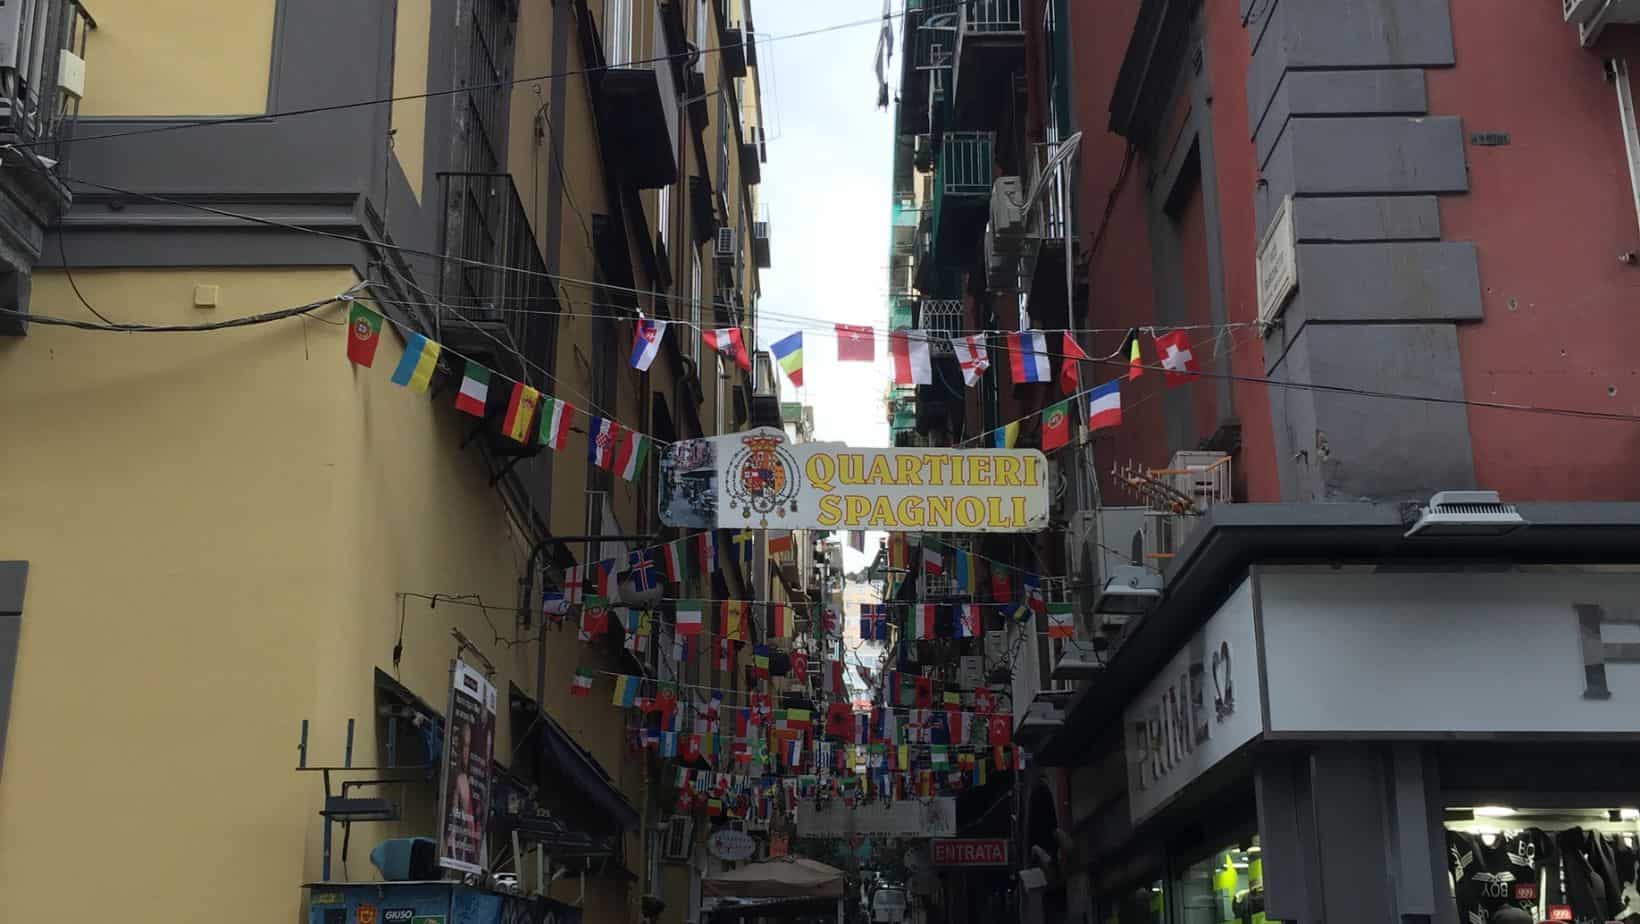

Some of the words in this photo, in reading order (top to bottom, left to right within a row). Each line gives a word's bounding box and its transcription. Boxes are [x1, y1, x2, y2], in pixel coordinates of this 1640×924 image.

[806, 454, 1038, 491] QUARTIERI
[818, 494, 1027, 528] SPAGNOLI
[1135, 661, 1210, 792] PRIME
[936, 844, 1002, 861] ENTRATA
[1482, 883, 1509, 897] BOY
[384, 911, 413, 920] GIUSO
